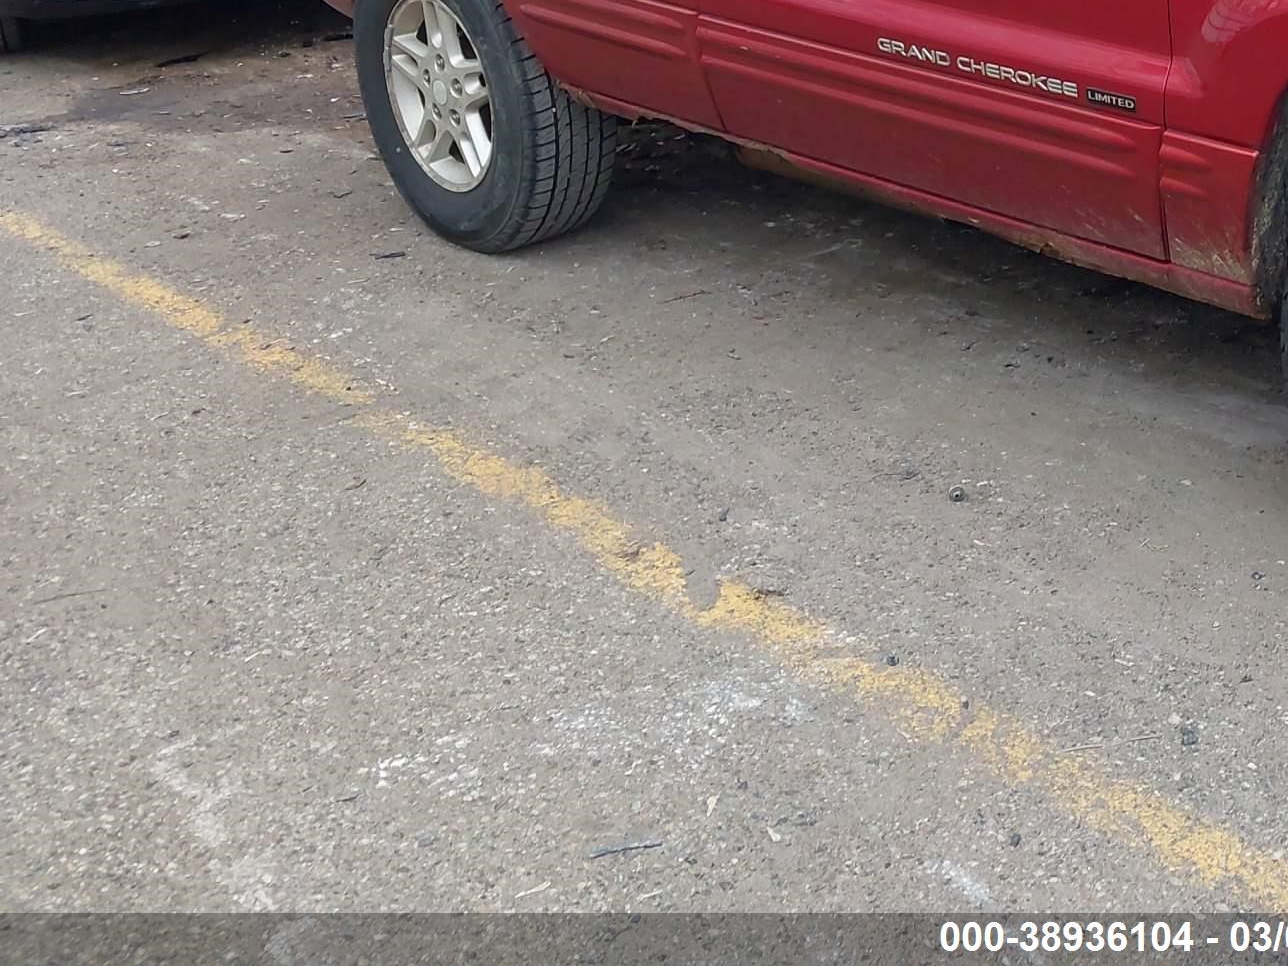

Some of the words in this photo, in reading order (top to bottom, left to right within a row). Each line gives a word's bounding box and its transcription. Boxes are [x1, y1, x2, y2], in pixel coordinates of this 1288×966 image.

[876, 37, 951, 66] GRAND
[956, 56, 1079, 98] CHEROKEE
[1087, 90, 1135, 110] LIMITED
